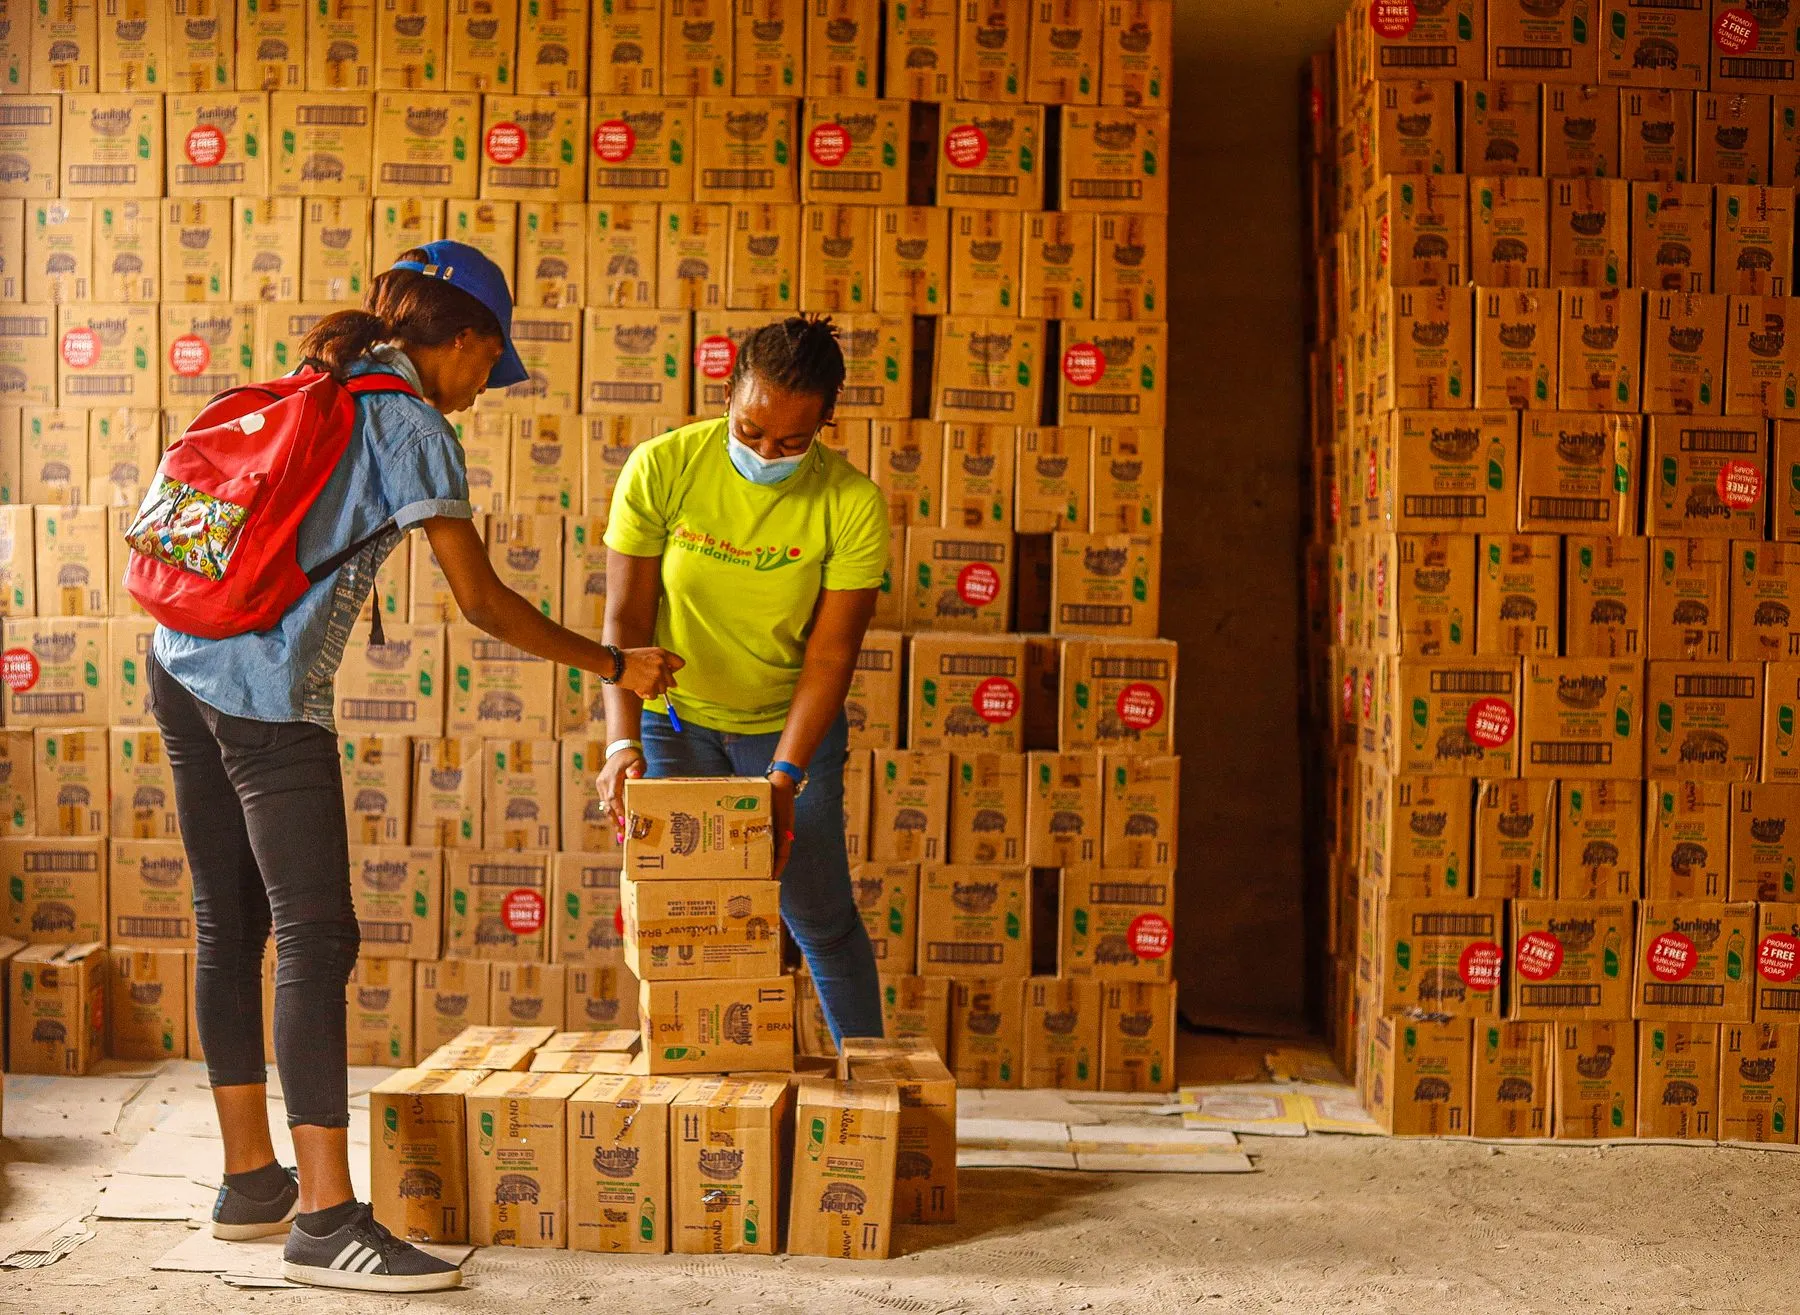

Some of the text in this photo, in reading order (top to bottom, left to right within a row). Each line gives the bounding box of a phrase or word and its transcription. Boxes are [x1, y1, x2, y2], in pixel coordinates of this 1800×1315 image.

[1386, 6, 1409, 15] FREE
[1727, 12, 1753, 28] PROMO!
[1718, 28, 1747, 45] SUNLIGHT
[1721, 19, 1751, 38] 2 FREE
[1720, 37, 1739, 50] SOAPS
[1430, 427, 1480, 446] Sunlight
[1558, 431, 1606, 449] Sunlight
[1734, 466, 1754, 475] SOAPS
[1726, 481, 1757, 494] 2 FREE
[1684, 502, 1732, 520] Sunlight
[674, 537, 751, 567] Foundation
[720, 540, 752, 557] Hope
[1558, 674, 1608, 692] Sunlight
[1475, 718, 1508, 735] 2 FREE
[670, 812, 684, 854] Sunlight
[637, 928, 662, 938] BRA
[665, 925, 718, 938] Unilever
[1672, 918, 1722, 936] Sunlight
[1521, 943, 1554, 960] 2 FREE
[1661, 937, 1689, 950] PROMO!
[1766, 939, 1795, 951] PROMO!
[1655, 944, 1688, 961] 2 FREE
[1762, 946, 1796, 961] 2 FREE
[1652, 955, 1685, 969] SUNLIGHT
[1760, 958, 1794, 970] SUNLIGHT
[1468, 966, 1492, 977] FREE
[1656, 965, 1678, 976] SOAPS
[1764, 967, 1785, 977] SOAPS
[740, 1004, 752, 1046] Sunlight
[510, 1100, 518, 1138] BRAND
[595, 1146, 640, 1162] Sunlight
[700, 1149, 744, 1163] Sunlight
[496, 1186, 539, 1204] Sunlight
[820, 1196, 864, 1215] Sunlight
